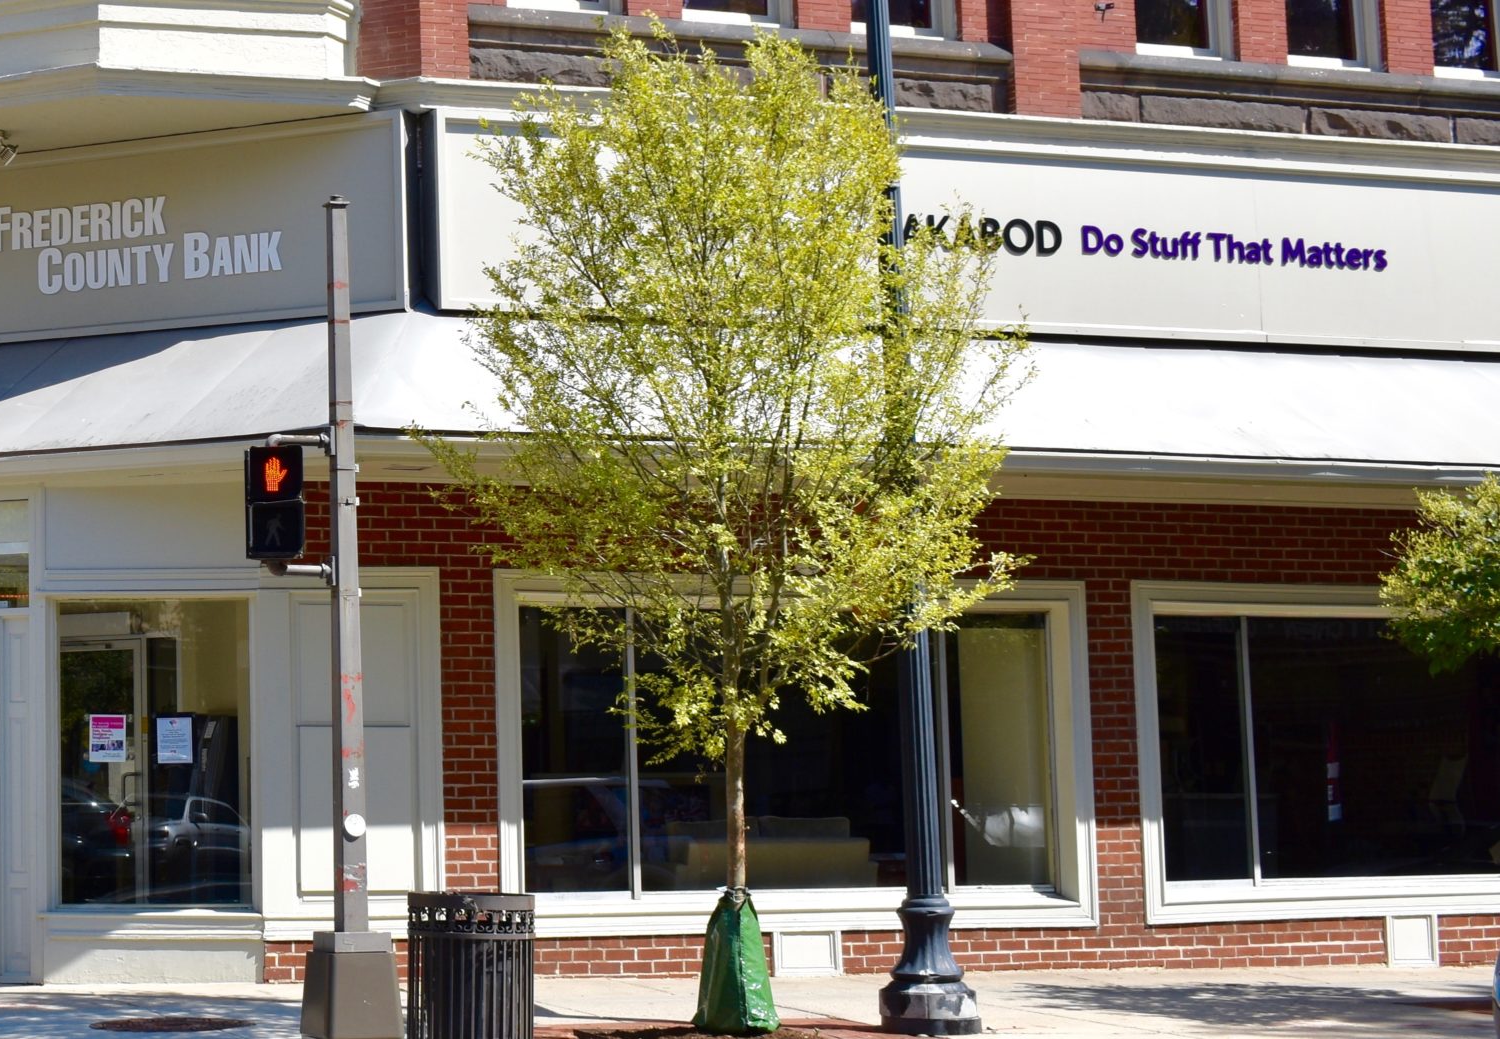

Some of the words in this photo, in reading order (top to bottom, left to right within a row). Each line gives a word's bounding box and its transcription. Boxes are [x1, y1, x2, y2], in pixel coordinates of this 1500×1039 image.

[38, 242, 175, 296] COUNTY
[183, 230, 283, 281] BANK
[1080, 225, 1124, 257] Do
[1130, 228, 1202, 261] Stuff
[1206, 232, 1274, 266] That
[1281, 237, 1388, 273] Matters
